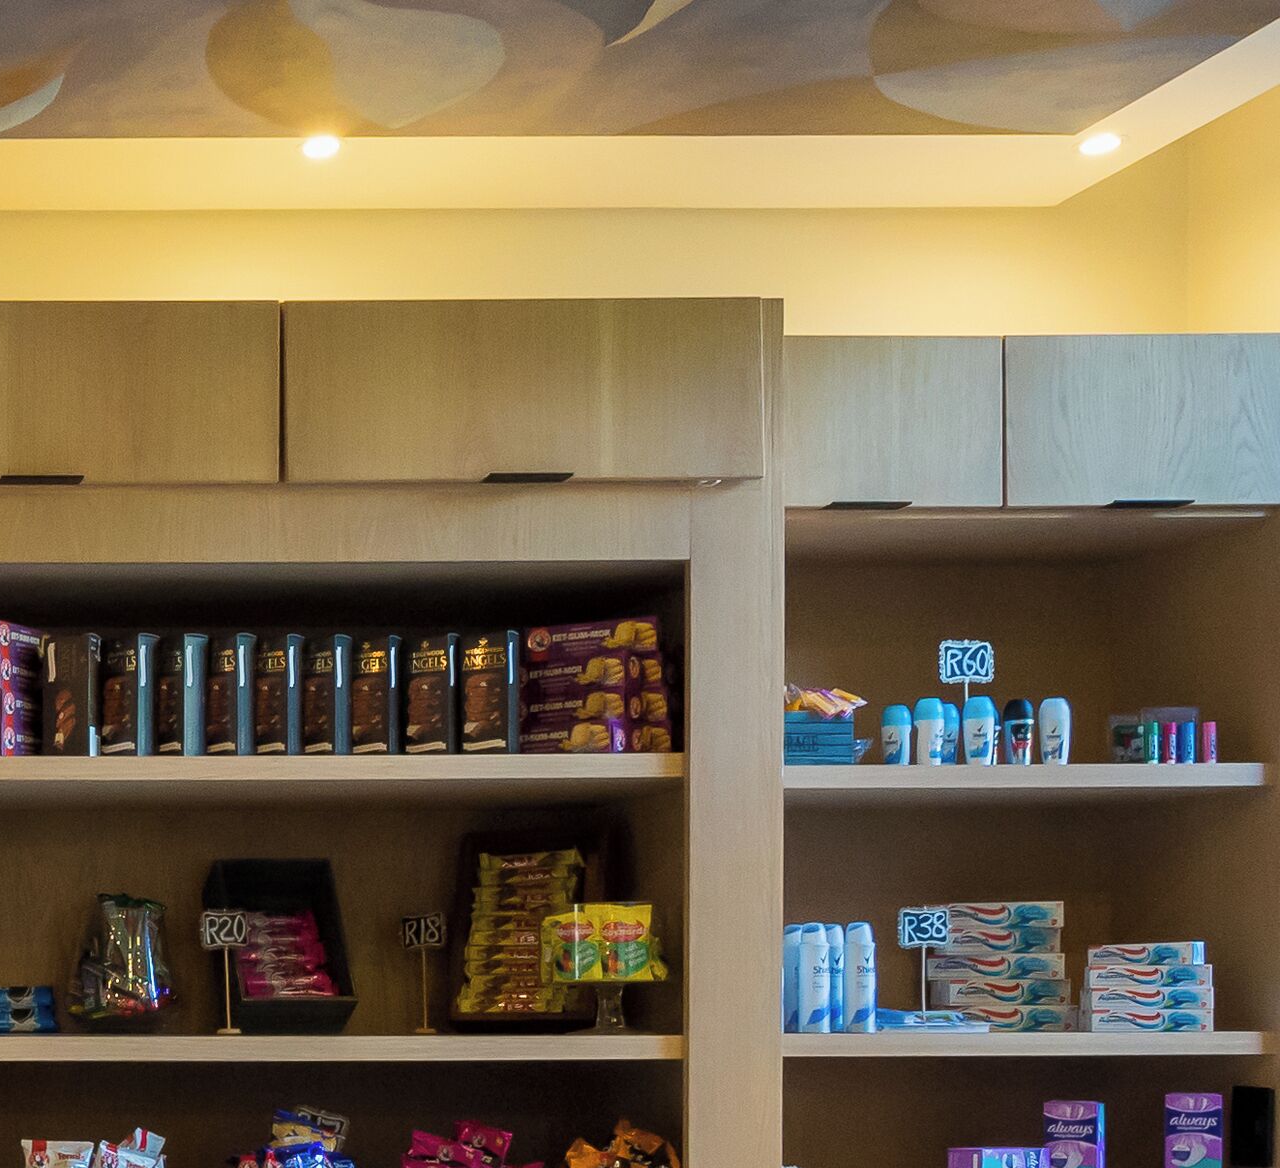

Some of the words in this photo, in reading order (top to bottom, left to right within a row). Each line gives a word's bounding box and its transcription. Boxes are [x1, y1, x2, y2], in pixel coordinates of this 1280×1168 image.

[361, 657, 388, 669] GELS
[412, 655, 447, 670] NGELS
[464, 653, 506, 668] ANGELS
[946, 648, 988, 677] R60
[206, 916, 246, 944] R20
[905, 912, 946, 944] R38
[1047, 1120, 1094, 1137] always
[1169, 1112, 1218, 1130] always
